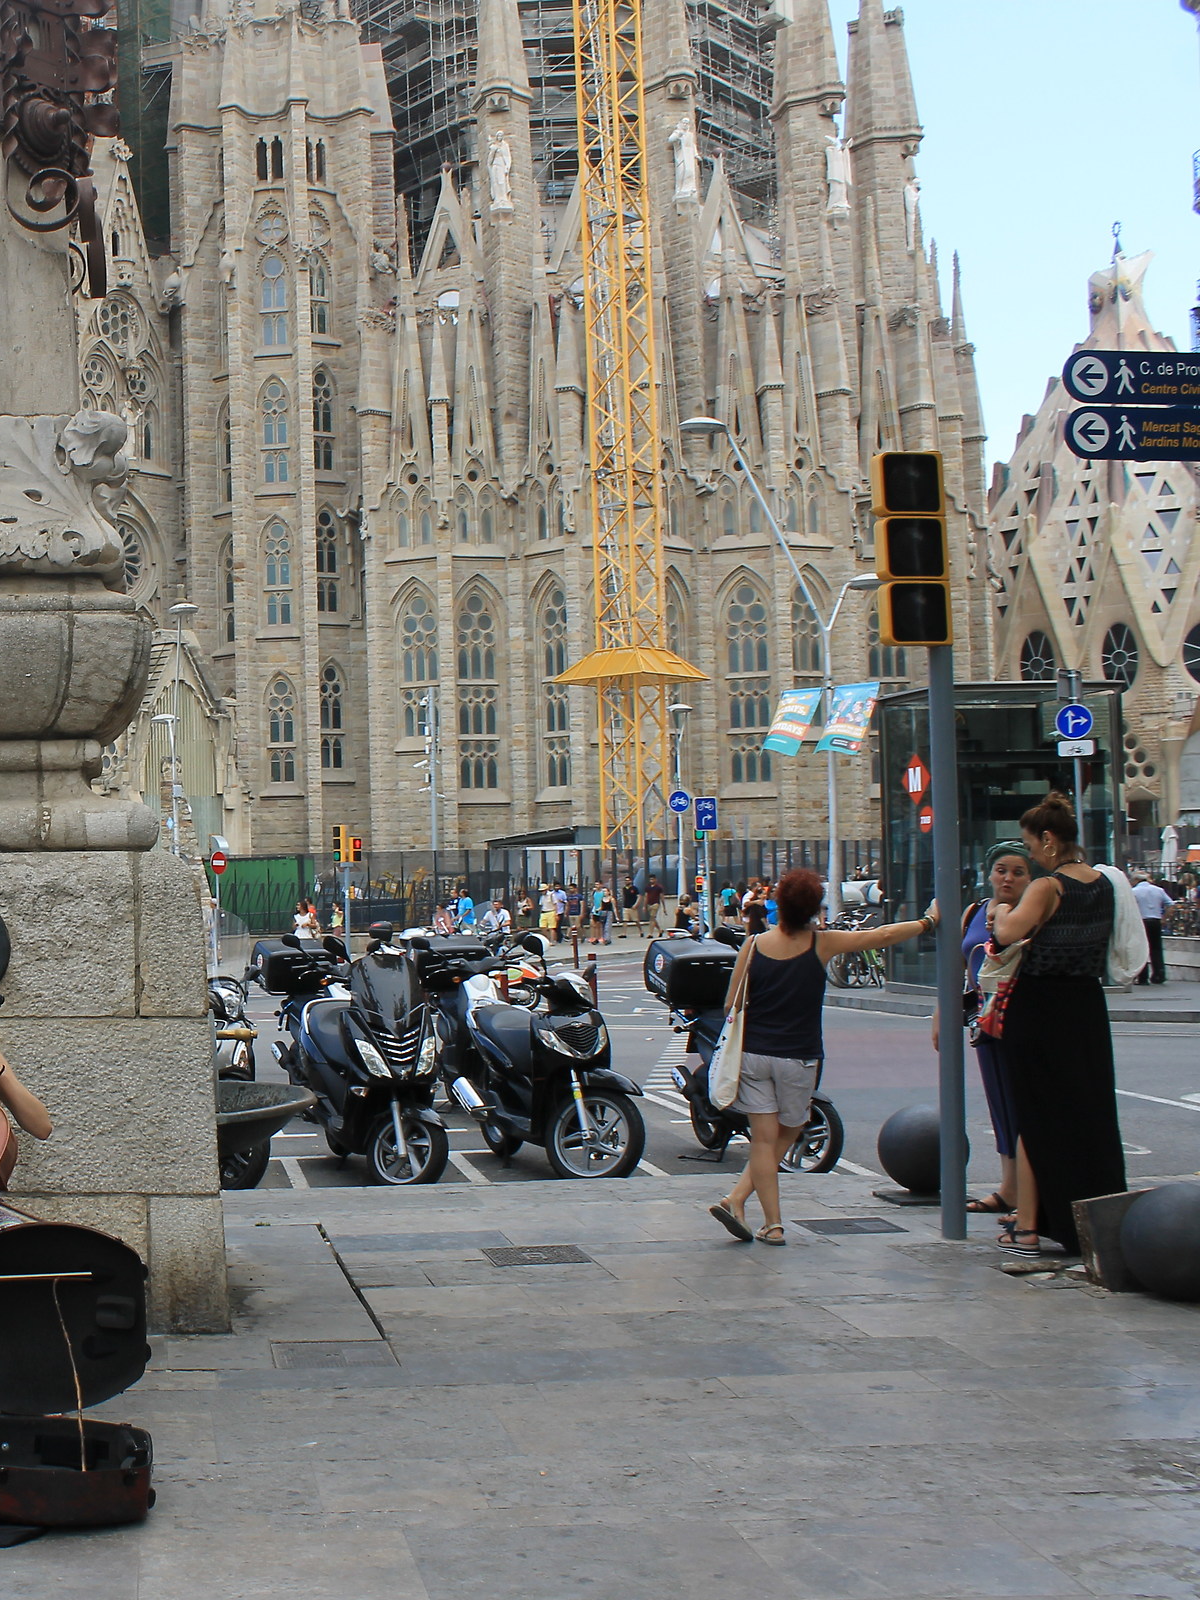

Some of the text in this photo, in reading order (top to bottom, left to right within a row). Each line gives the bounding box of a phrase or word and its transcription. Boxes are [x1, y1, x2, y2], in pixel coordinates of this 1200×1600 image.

[1139, 361, 1154, 375] C.
[1157, 362, 1174, 375] de
[1141, 382, 1178, 394] Centre
[1142, 421, 1181, 433] Mercat
[1139, 436, 1200, 448] Jardins Mo
[908, 766, 922, 793] M
